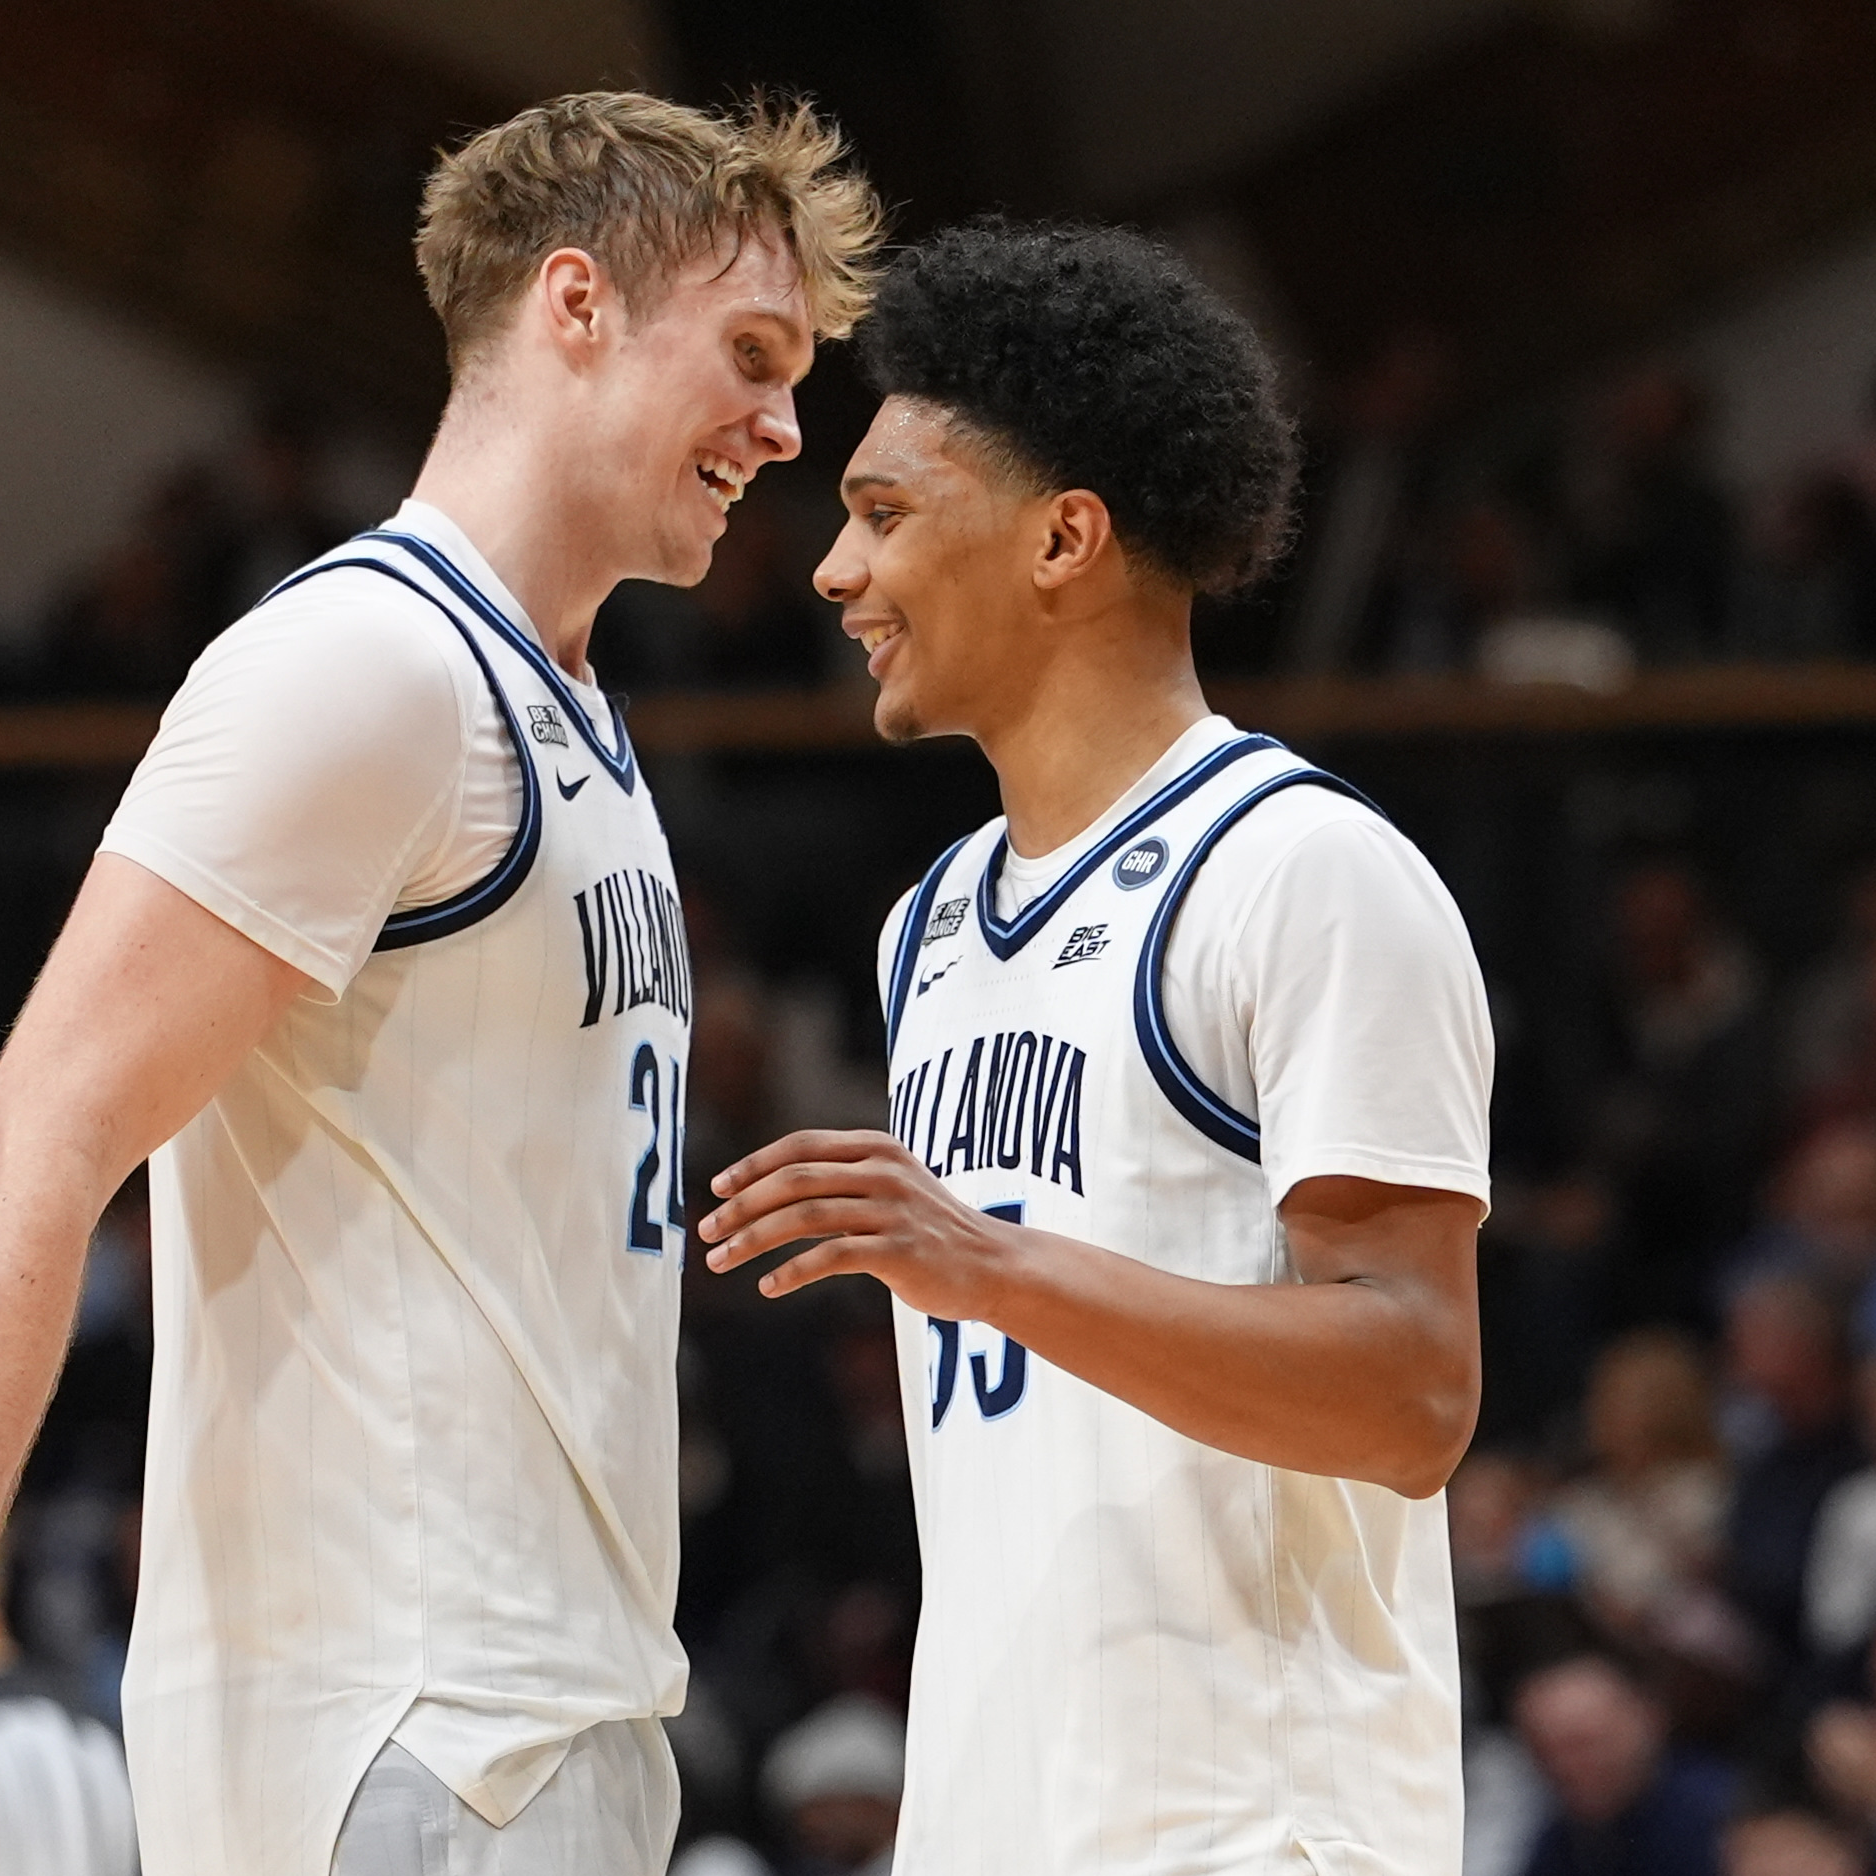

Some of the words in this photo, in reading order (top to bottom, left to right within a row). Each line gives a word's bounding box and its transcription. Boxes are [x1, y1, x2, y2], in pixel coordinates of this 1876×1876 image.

[926, 918, 964, 939] ANGE
[1067, 923, 1109, 944] BIG
[1057, 940, 1112, 960] EAST
